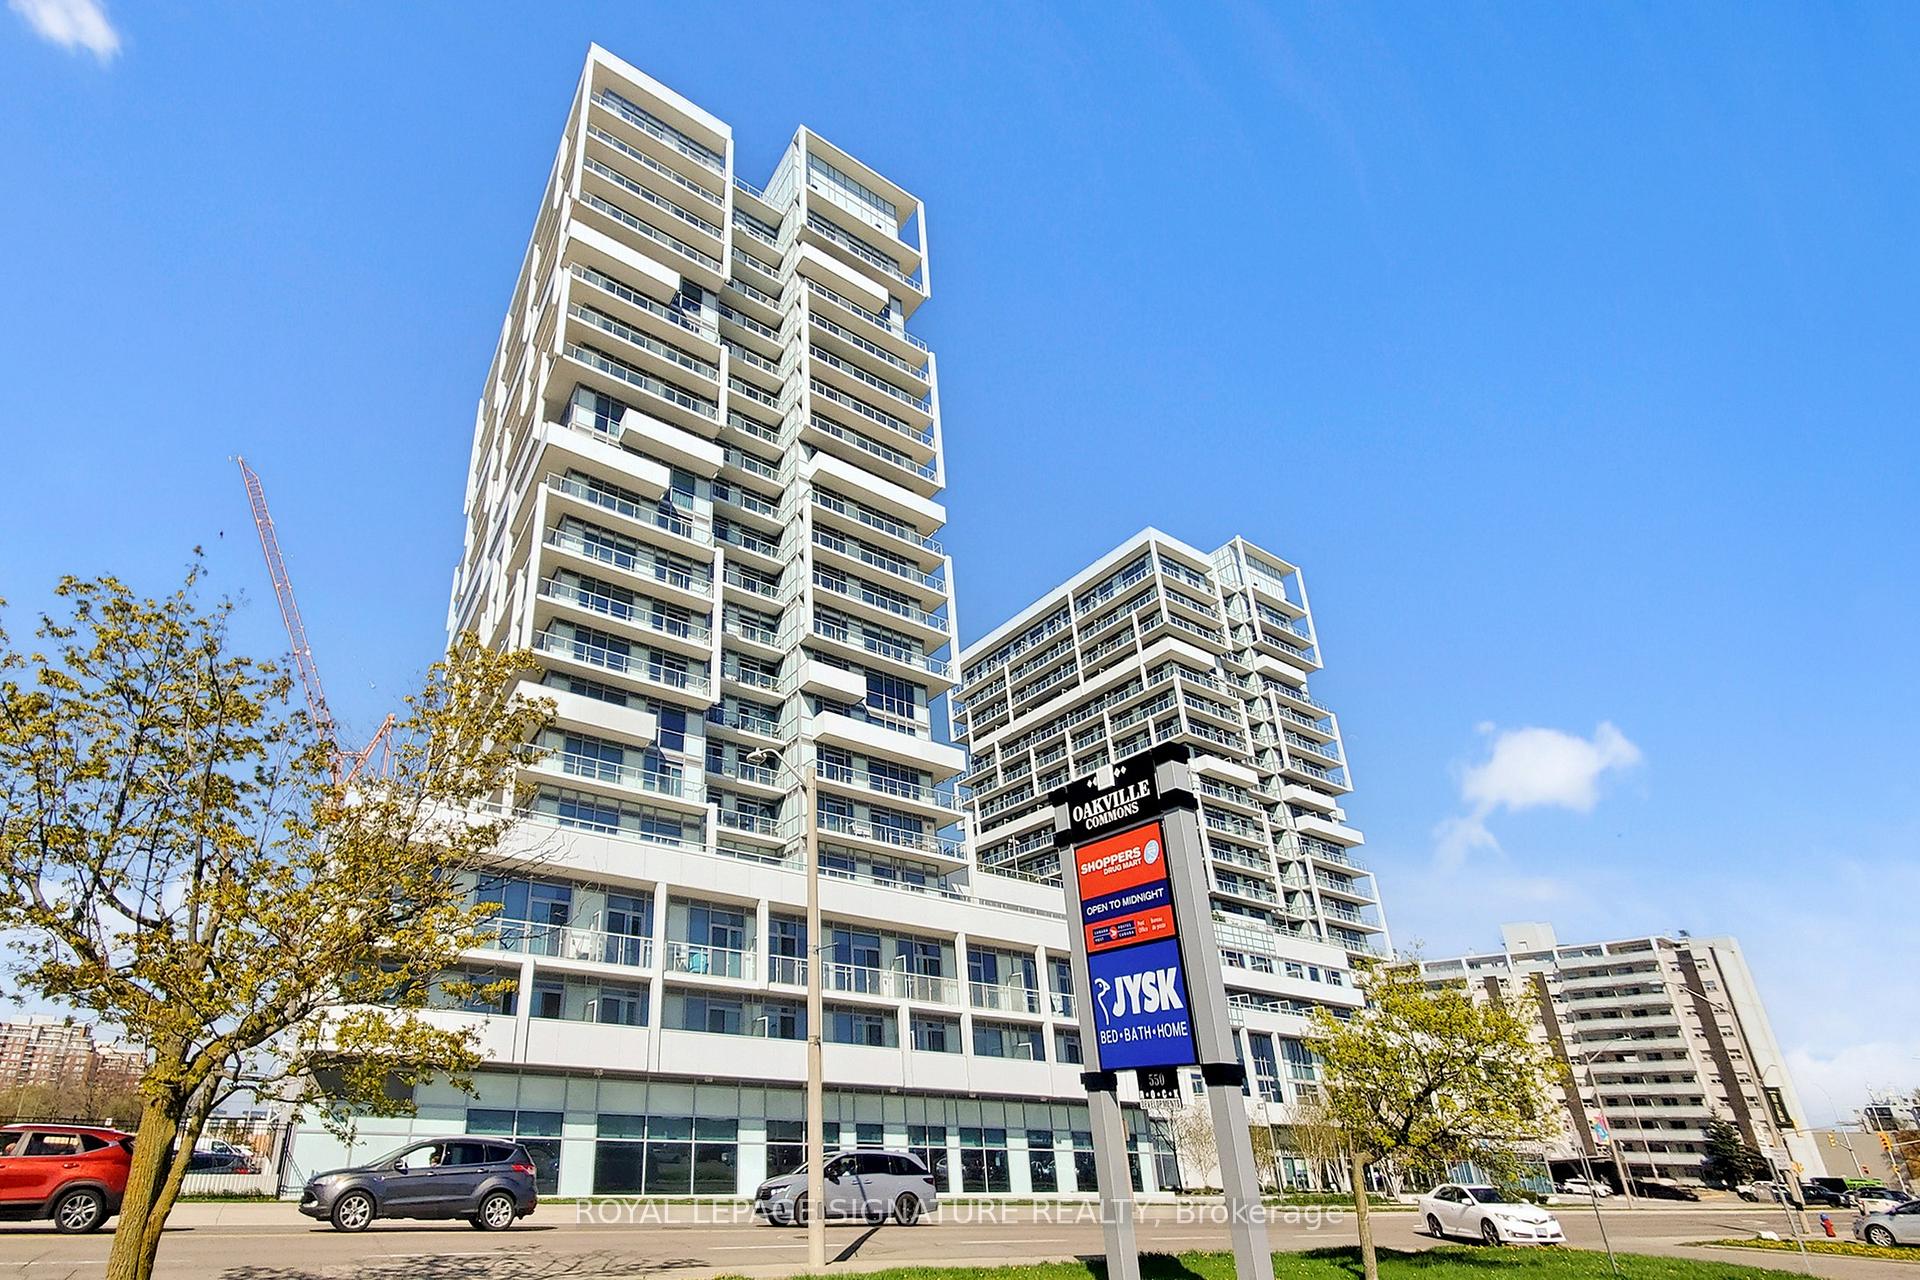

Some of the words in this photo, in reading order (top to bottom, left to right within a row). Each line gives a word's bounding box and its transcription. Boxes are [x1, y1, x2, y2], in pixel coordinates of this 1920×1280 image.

[1073, 779, 1150, 822] OAKVILLE
[1085, 801, 1139, 830] COMMONS
[1081, 847, 1142, 875] SHOPPERS
[1103, 864, 1122, 876] DRUG
[1123, 858, 1142, 870] MART
[1086, 901, 1109, 916] OPEN
[1109, 899, 1121, 910] TO
[1122, 888, 1164, 907] MIDNIGHT
[1112, 967, 1184, 1018] JYSK
[1148, 1072, 1165, 1087] 550
